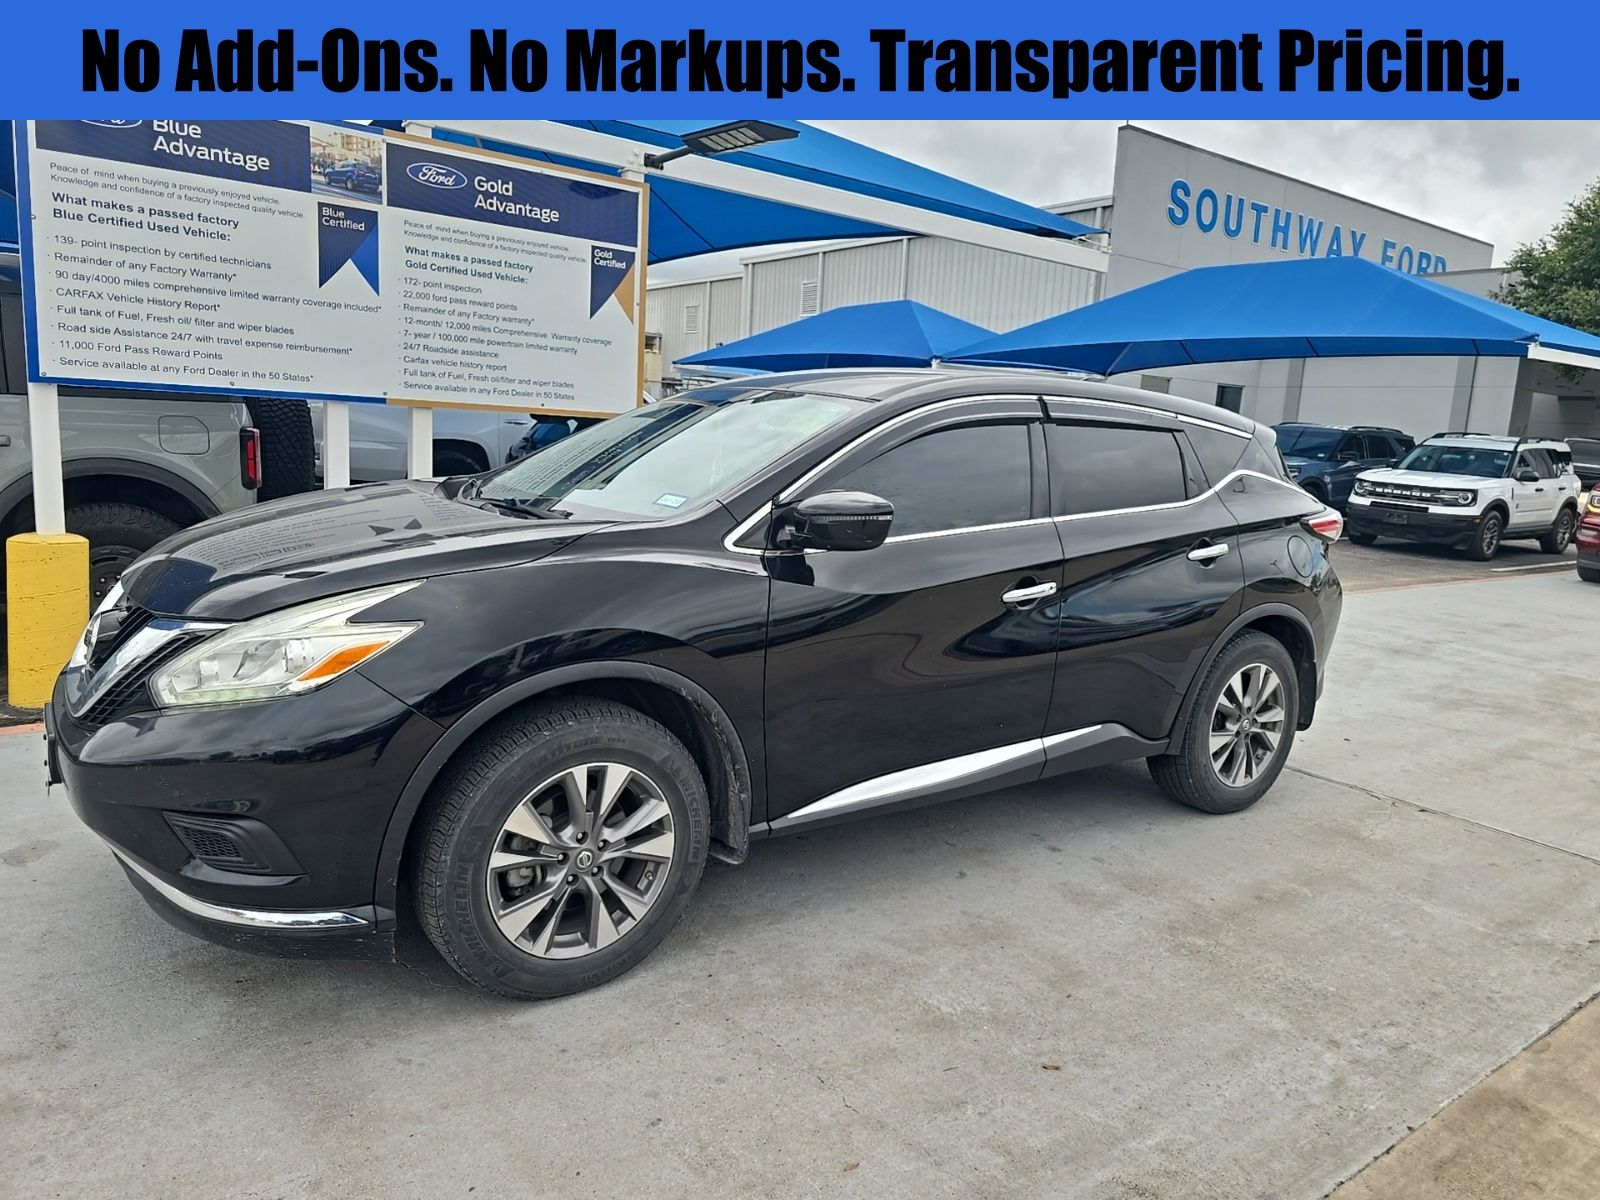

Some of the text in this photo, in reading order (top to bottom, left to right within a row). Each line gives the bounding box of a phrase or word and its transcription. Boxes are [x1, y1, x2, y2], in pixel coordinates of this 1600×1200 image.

[153, 120, 202, 138] Blue
[153, 135, 270, 171] Advantage
[49, 161, 78, 173] Peace
[79, 167, 89, 175] of
[93, 170, 115, 179] mind
[116, 173, 140, 182] when
[141, 177, 169, 189] buying
[178, 183, 219, 197] previously
[220, 190, 251, 200] enjoyed
[418, 165, 456, 186] Ford
[474, 175, 513, 196] Gold
[51, 192, 239, 229] What makes a passed factory
[322, 206, 345, 219] Blue
[474, 194, 560, 223] Advantage
[1167, 178, 1367, 259] SOUTHWAY
[52, 208, 230, 241] Blue Certified Used Vehicle:
[322, 216, 365, 231] Certified
[53, 234, 271, 269] 139- point inspection by certified technicians
[404, 245, 429, 256] What
[430, 251, 461, 261] makes
[470, 257, 502, 267] passed
[503, 260, 533, 273] factory
[594, 249, 613, 259] Gold
[53, 252, 113, 266] Remainder
[115, 259, 126, 268] of
[127, 262, 147, 272] any
[149, 263, 187, 277] Factory
[404, 259, 528, 284] Gold Certified Used Vehicle:
[594, 257, 626, 269] Certified
[54, 269, 69, 279] 90
[71, 272, 120, 285] day/4000
[123, 278, 150, 288] miles
[152, 282, 227, 296] comprehensive
[229, 289, 259, 300] limited
[261, 294, 300, 305] warranty
[301, 298, 342, 310] coverage
[55, 287, 103, 300] CARFAX
[106, 292, 144, 304] Vehicle
[146, 297, 182, 309] History
[422, 280, 442, 289] point
[443, 283, 482, 294] inspection
[402, 289, 518, 311] 22,000 ford pass reward points
[56, 304, 76, 314] Full
[78, 307, 102, 317] tank
[104, 309, 115, 318] of
[117, 310, 143, 322] Fuel,
[145, 313, 175, 323] Fresh
[193, 317, 215, 327] filter
[217, 321, 235, 329] and
[236, 322, 262, 332] wiper
[264, 324, 294, 335] blades
[402, 303, 446, 315] Remainder
[446, 308, 455, 316] of
[456, 311, 471, 319] any
[472, 311, 500, 323] Factory
[57, 322, 86, 333] Road
[89, 326, 111, 334] side
[112, 327, 168, 339] Assistance
[170, 331, 192, 341] 24/7
[194, 334, 214, 343] with
[216, 336, 242, 346] travel
[244, 340, 283, 349] expense
[471, 325, 491, 333] miles
[492, 326, 548, 338] Comprehensive
[550, 332, 581, 343] Warranty
[581, 337, 612, 347] coverage
[59, 340, 223, 360] 11,000 Ford Pass Reward Points
[402, 342, 499, 358] 24/7 Roadside assistance
[58, 356, 99, 367] Service
[101, 361, 147, 371] available
[149, 364, 160, 372] at
[161, 365, 180, 374] any
[182, 365, 205, 375] Ford
[207, 367, 239, 377] Dealer
[241, 369, 249, 378] in
[251, 370, 266, 379] the
[268, 371, 280, 380] 50
[402, 355, 429, 364] Carfax
[430, 358, 458, 367] vehicle
[459, 360, 484, 371] history
[402, 380, 433, 390] Service
[433, 384, 468, 392] available
[469, 385, 476, 393] in
[477, 387, 491, 396] any
[492, 387, 509, 396] Ford
[510, 388, 534, 397] Dealer
[542, 391, 553, 399] 50
[553, 392, 574, 400] States
